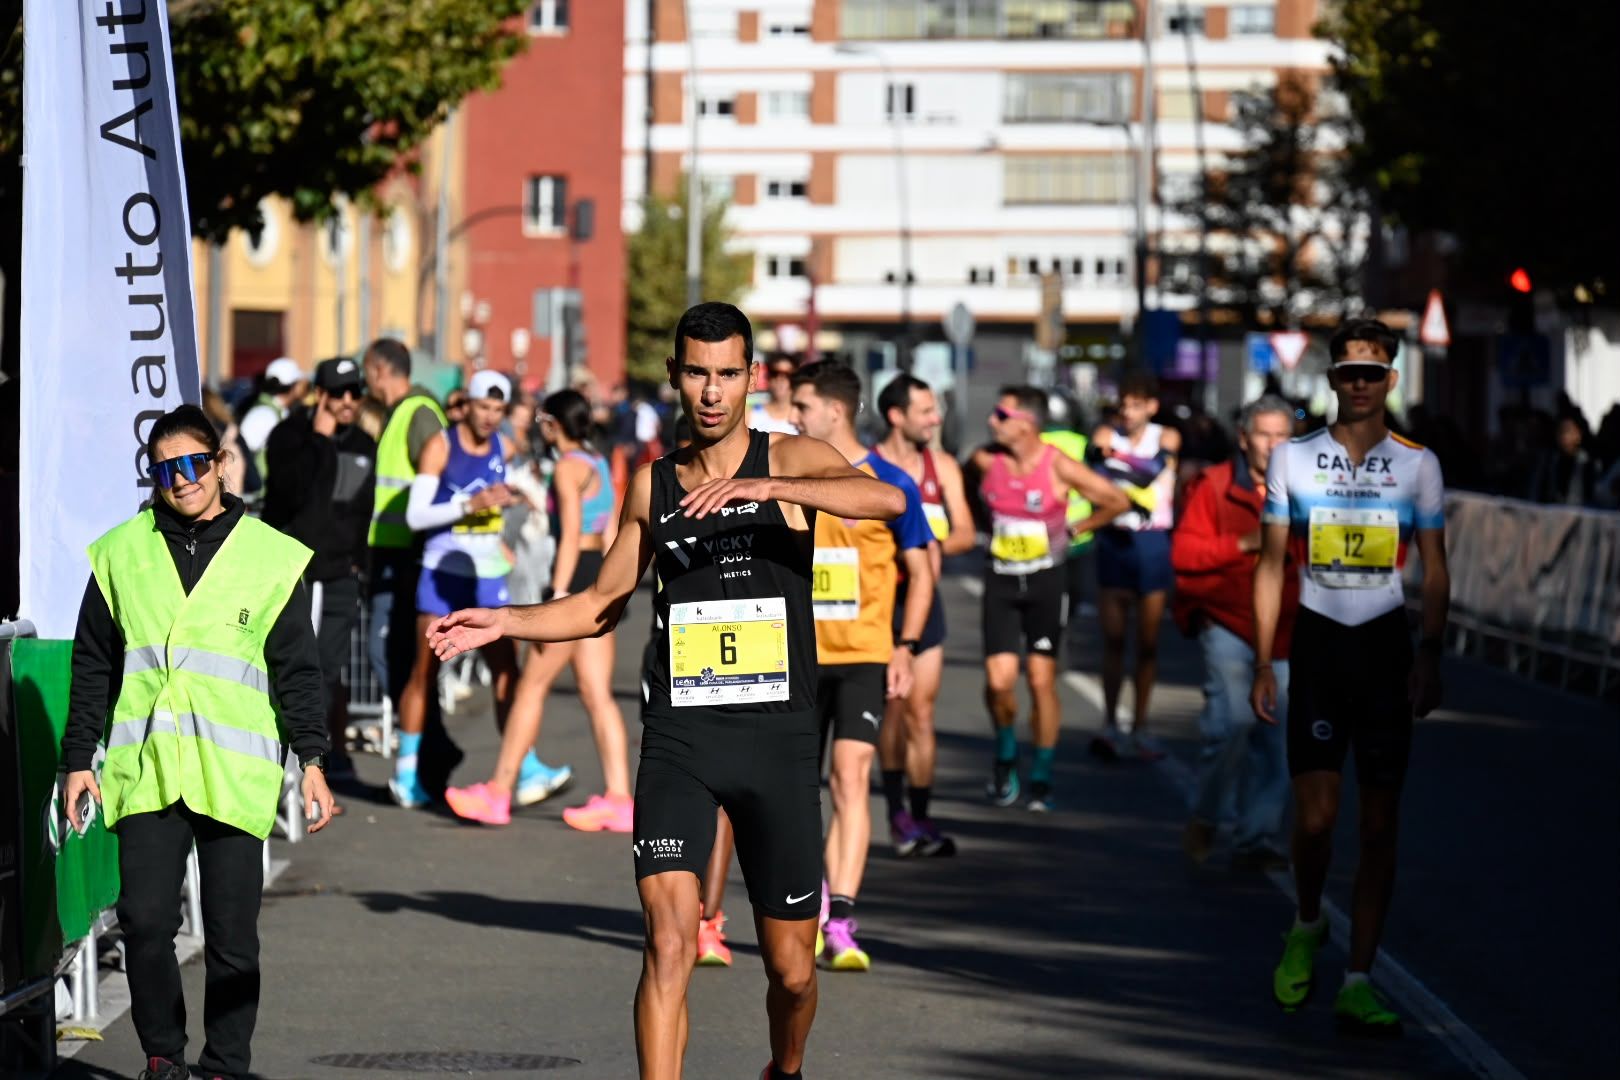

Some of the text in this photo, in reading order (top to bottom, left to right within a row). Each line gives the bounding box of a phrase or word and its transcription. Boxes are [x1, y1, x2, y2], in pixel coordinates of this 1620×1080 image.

[703, 533, 754, 552] VICKY
[1344, 532, 1365, 559] 12
[712, 550, 751, 566] FOODS
[712, 624, 742, 633] ALONSO
[719, 632, 737, 665] 6
[648, 838, 683, 847] VICKY
